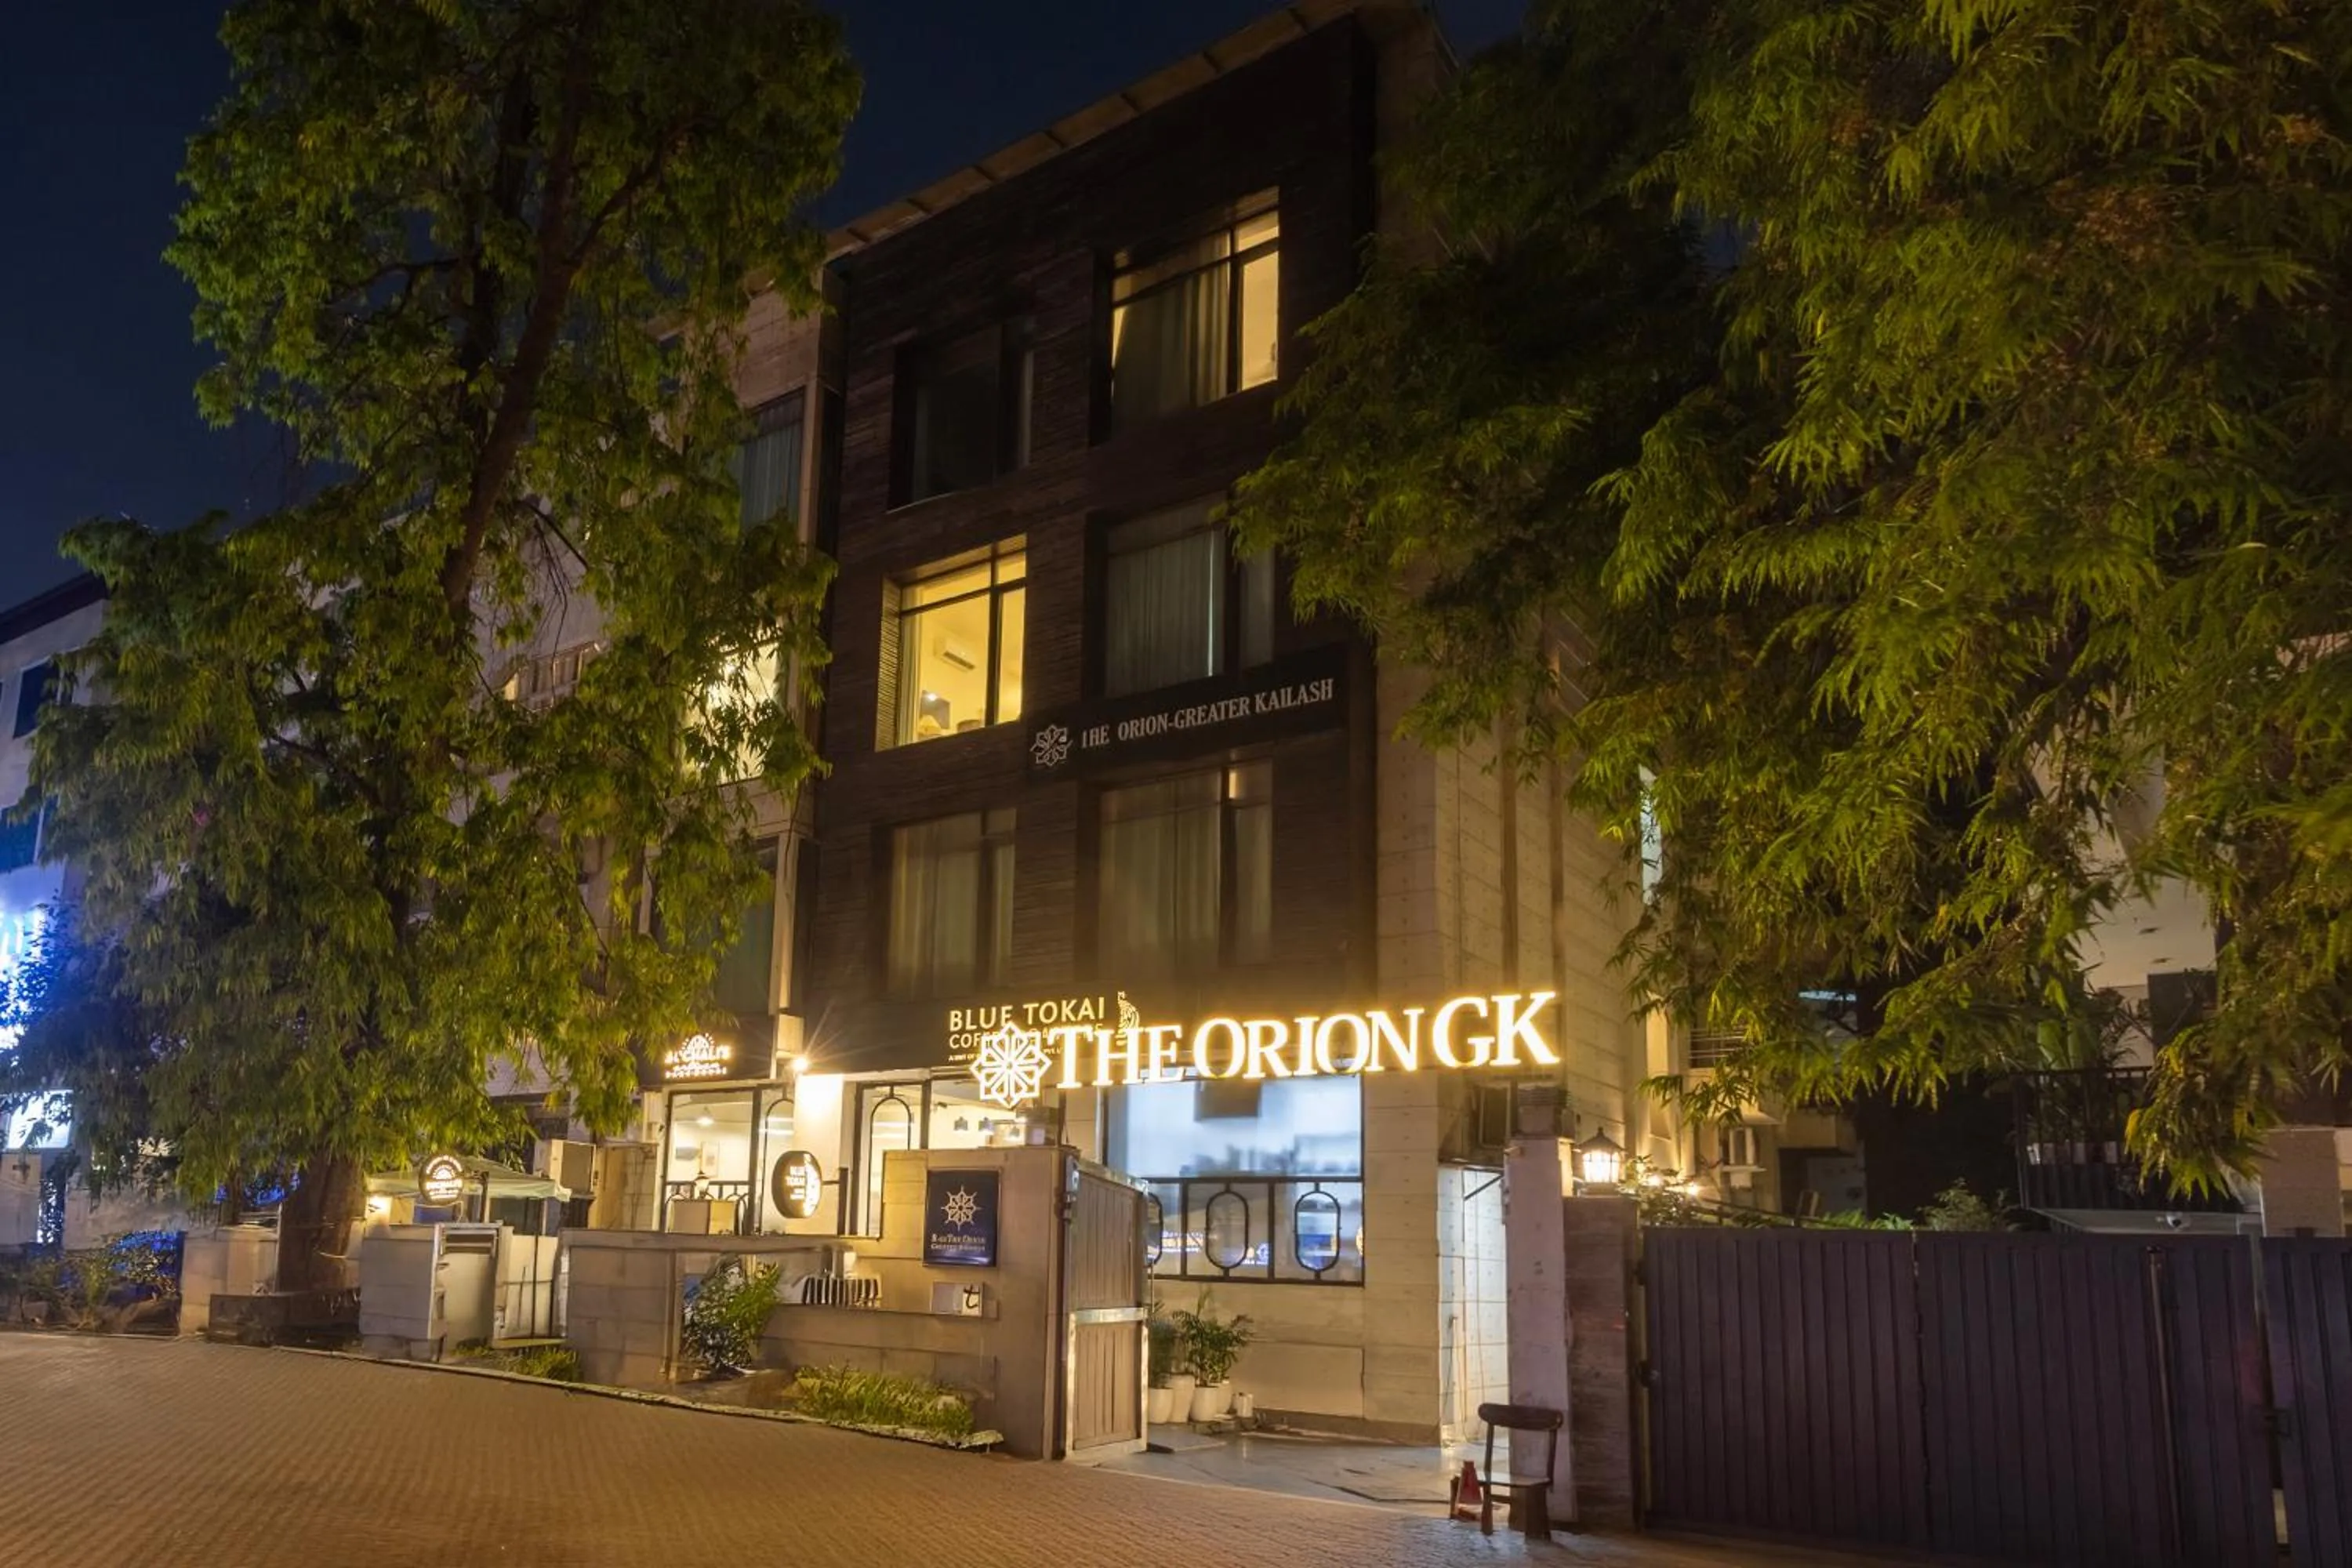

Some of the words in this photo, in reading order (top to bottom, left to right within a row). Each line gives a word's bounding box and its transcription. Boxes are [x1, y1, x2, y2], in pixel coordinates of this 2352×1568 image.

[1117, 696, 1250, 741] ORION-GREATER
[1255, 678, 1334, 713] KAILASH
[949, 1005, 1013, 1032] BLUE
[1022, 996, 1105, 1025] TOKAI
[1047, 1024, 1185, 1089] THE
[1192, 1008, 1425, 1080] ORION
[1432, 991, 1561, 1068] GK
